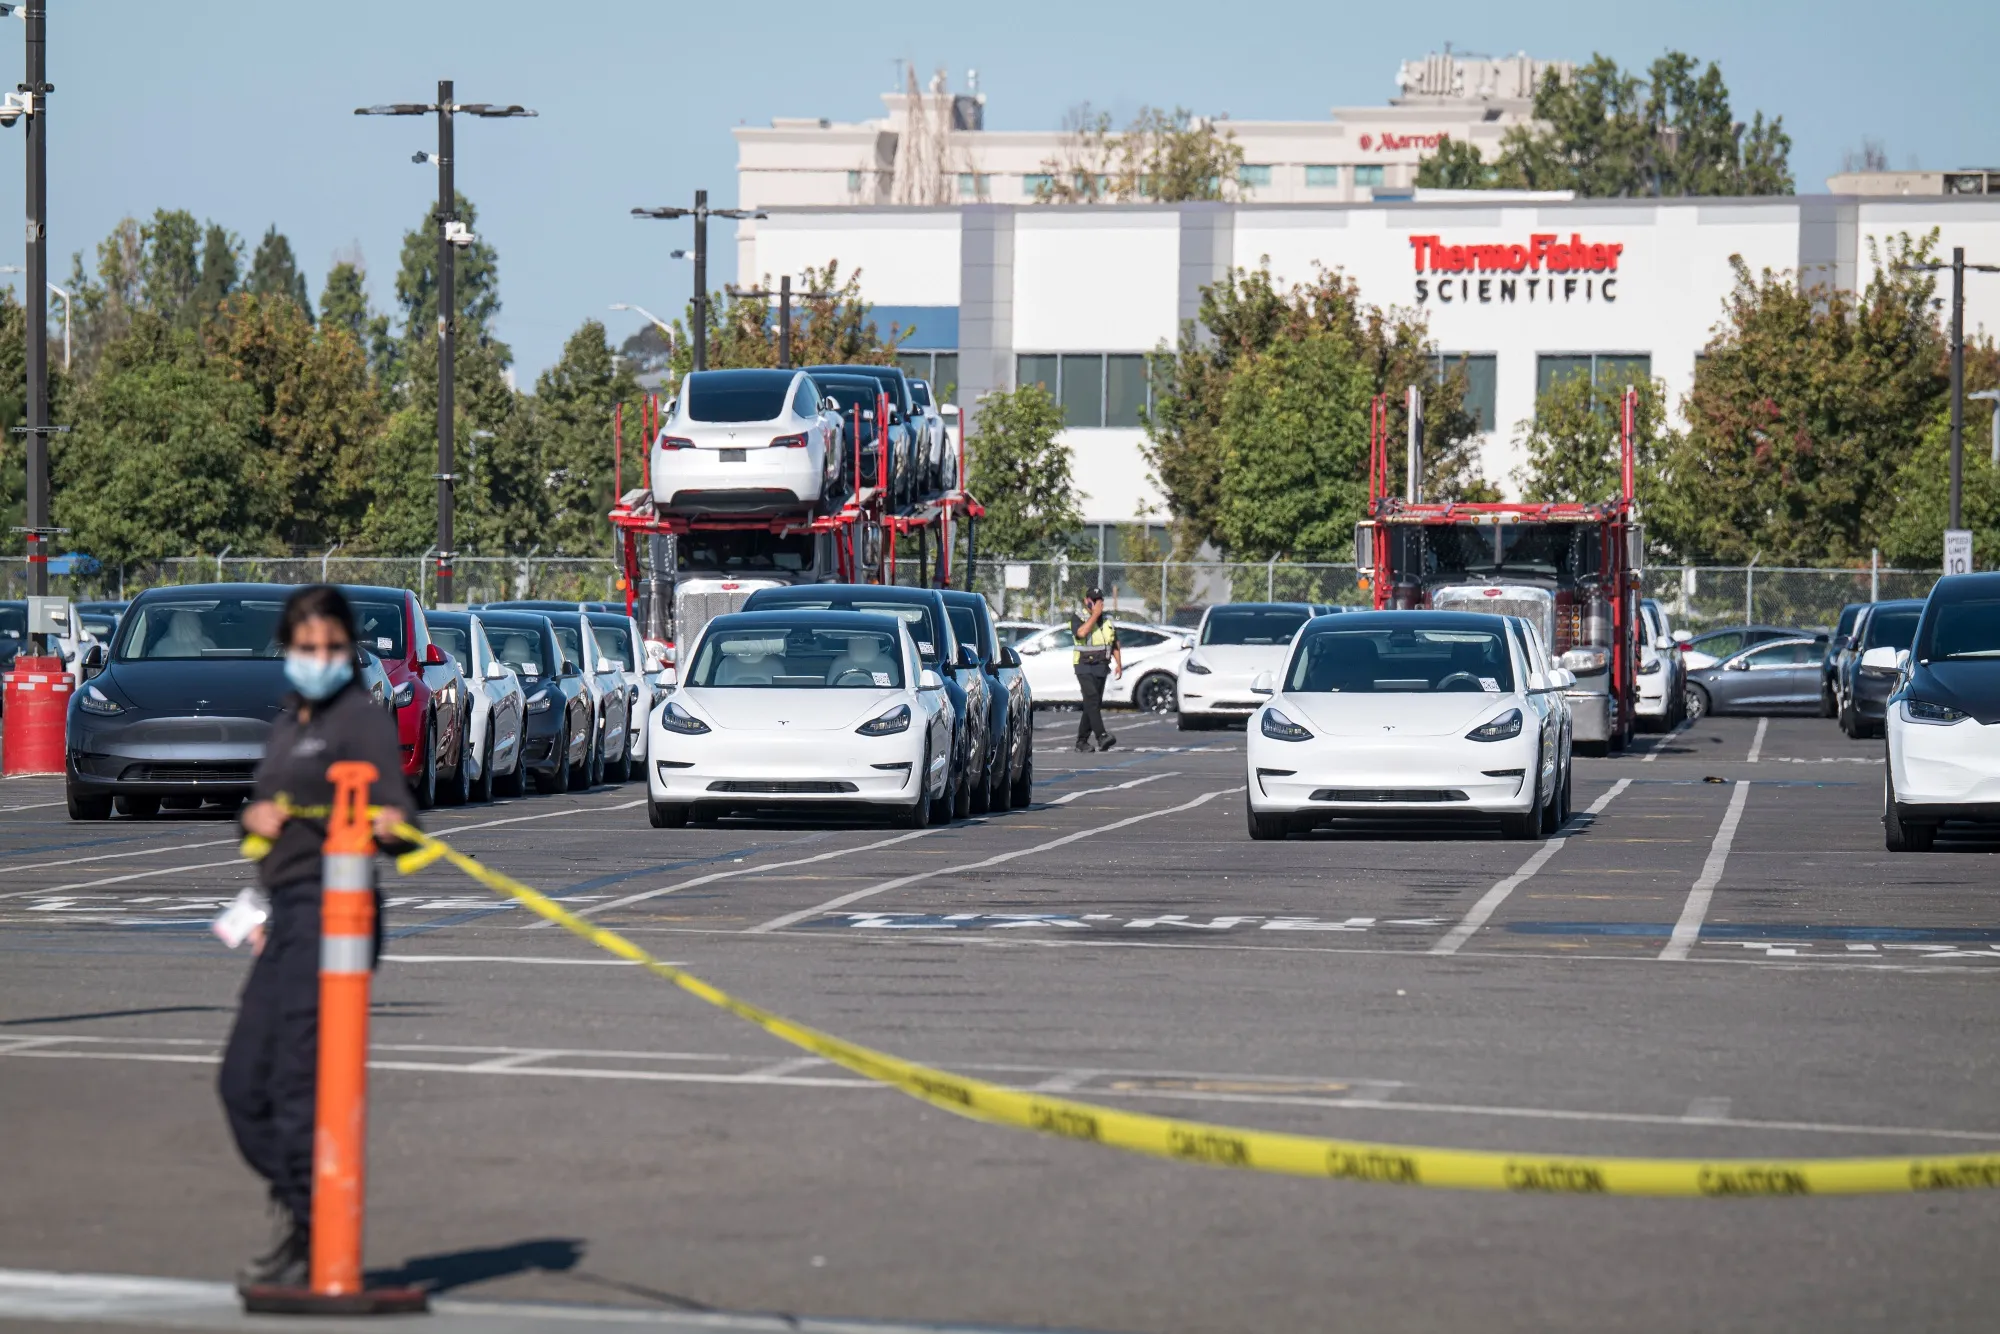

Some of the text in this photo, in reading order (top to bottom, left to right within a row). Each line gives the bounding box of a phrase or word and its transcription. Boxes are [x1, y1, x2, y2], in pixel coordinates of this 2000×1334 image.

[1415, 278, 1617, 303] SCIENTIFIC
[1948, 536, 1969, 545] SPEED
[1950, 558, 1966, 574] 10
[1168, 1128, 1250, 1170] CAUTION
[1325, 1147, 1420, 1185] CAUTION
[1504, 1160, 1610, 1194] CAUTION
[1698, 1163, 1812, 1197] CAUTION
